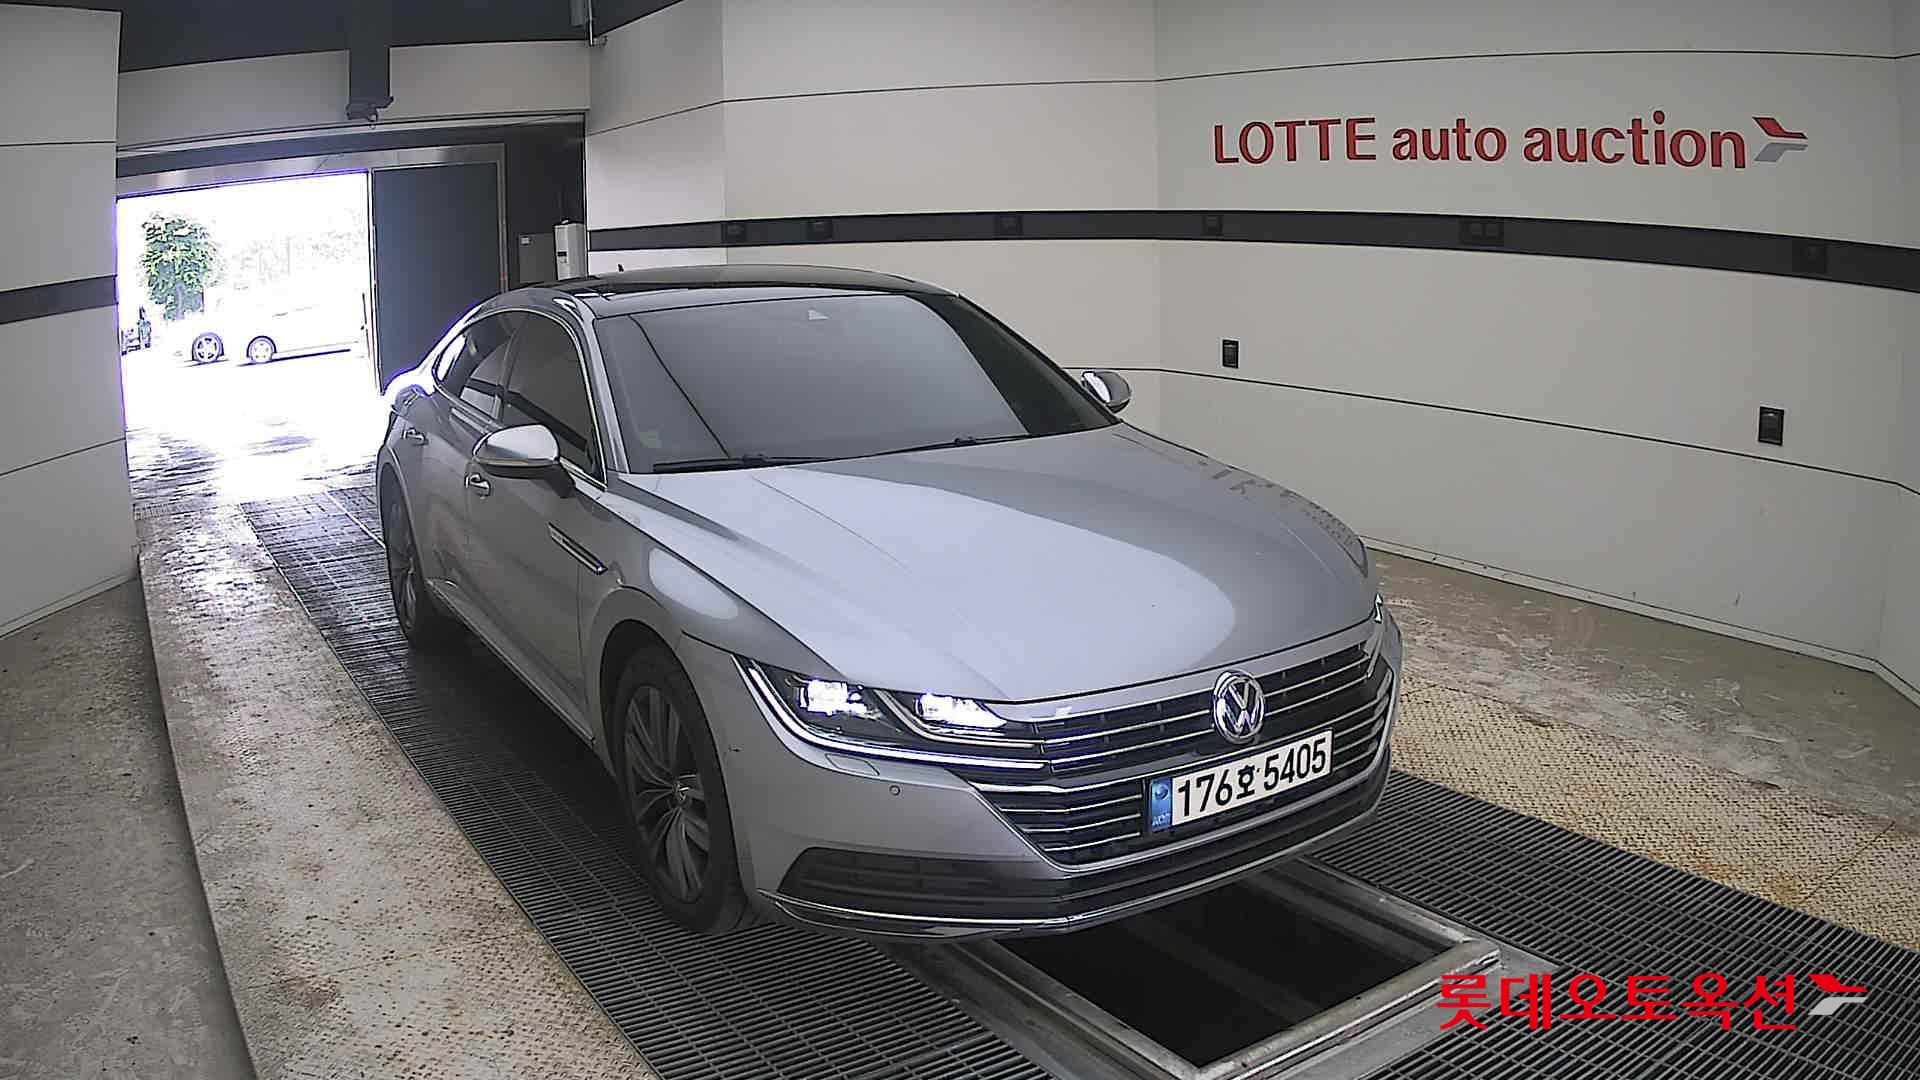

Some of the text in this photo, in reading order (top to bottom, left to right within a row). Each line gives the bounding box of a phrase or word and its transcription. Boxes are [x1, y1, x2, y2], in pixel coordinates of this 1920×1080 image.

[1213, 110, 1746, 169] LOTTE auto auction
[1263, 737, 1327, 792] 5405
